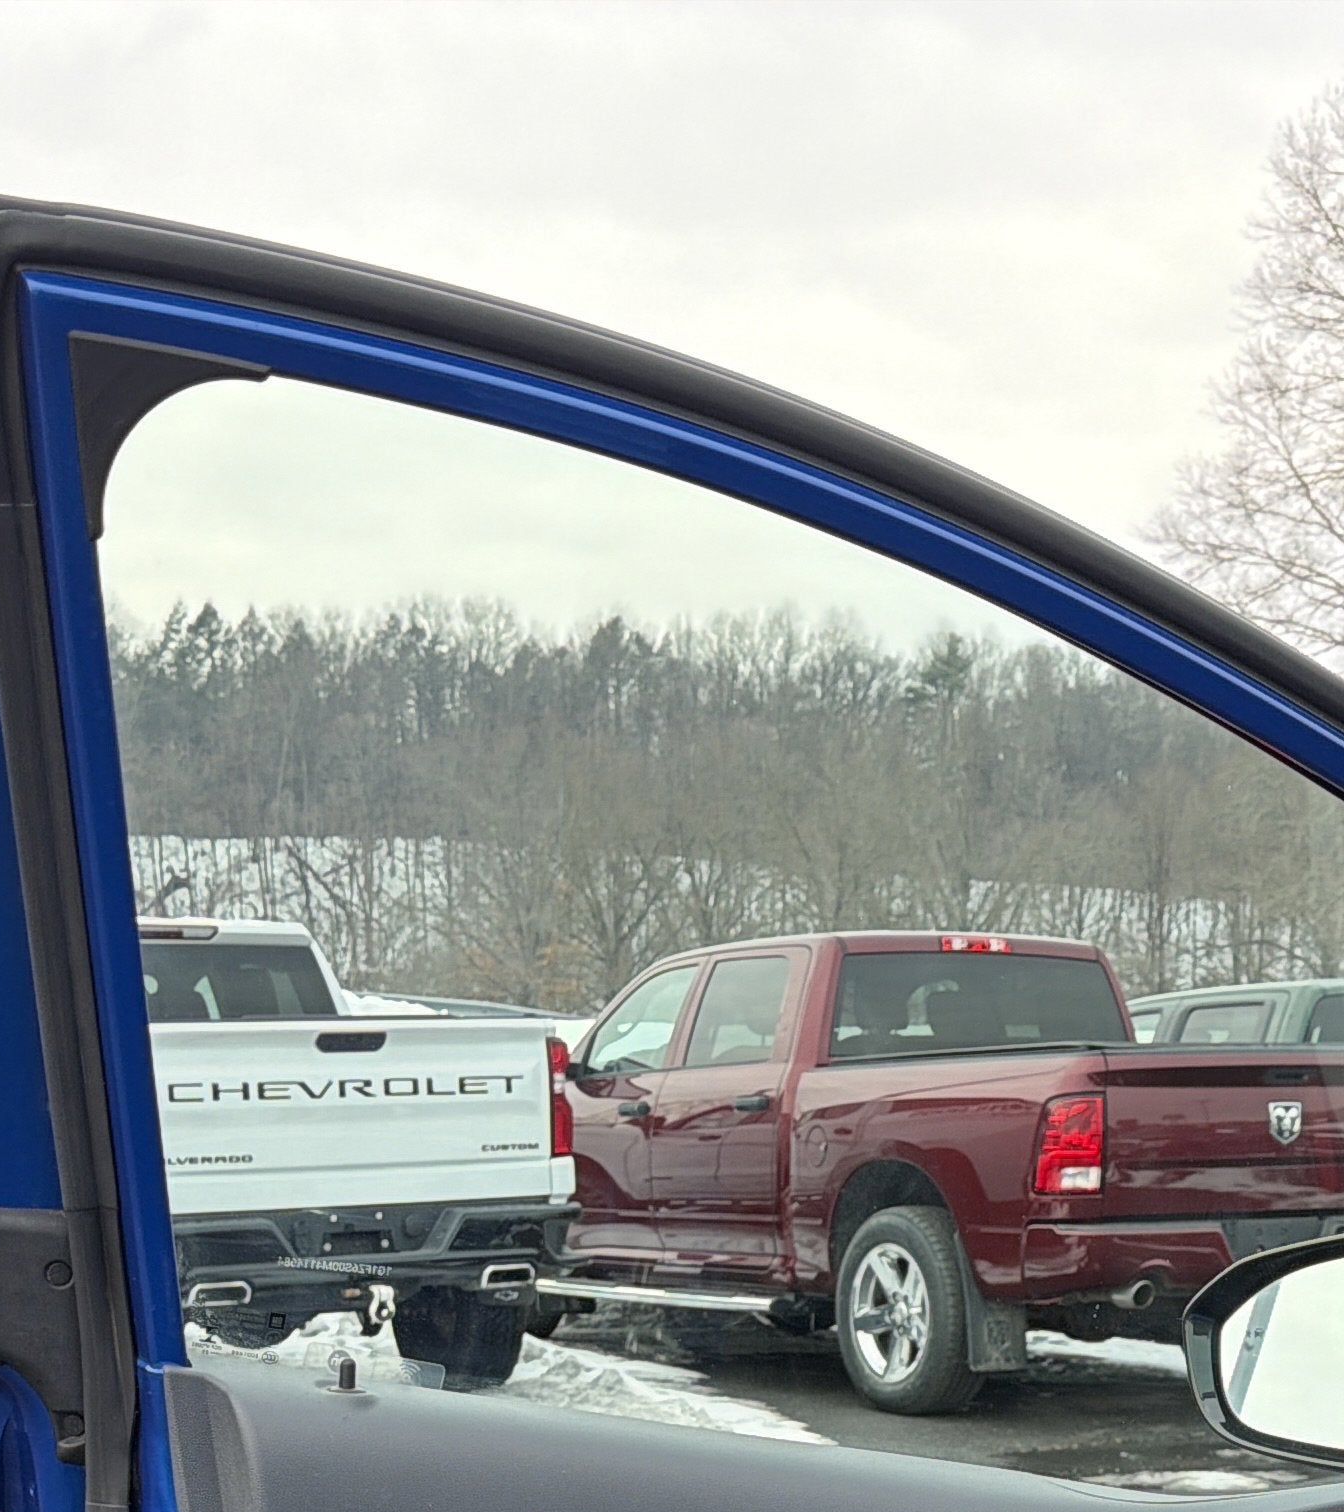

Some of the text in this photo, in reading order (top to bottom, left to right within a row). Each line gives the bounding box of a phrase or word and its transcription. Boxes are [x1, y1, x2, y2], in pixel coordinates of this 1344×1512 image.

[167, 1075, 524, 1102] CHEVROLET
[481, 1143, 540, 1152] CUSTOM
[167, 1154, 254, 1166] LVERADO
